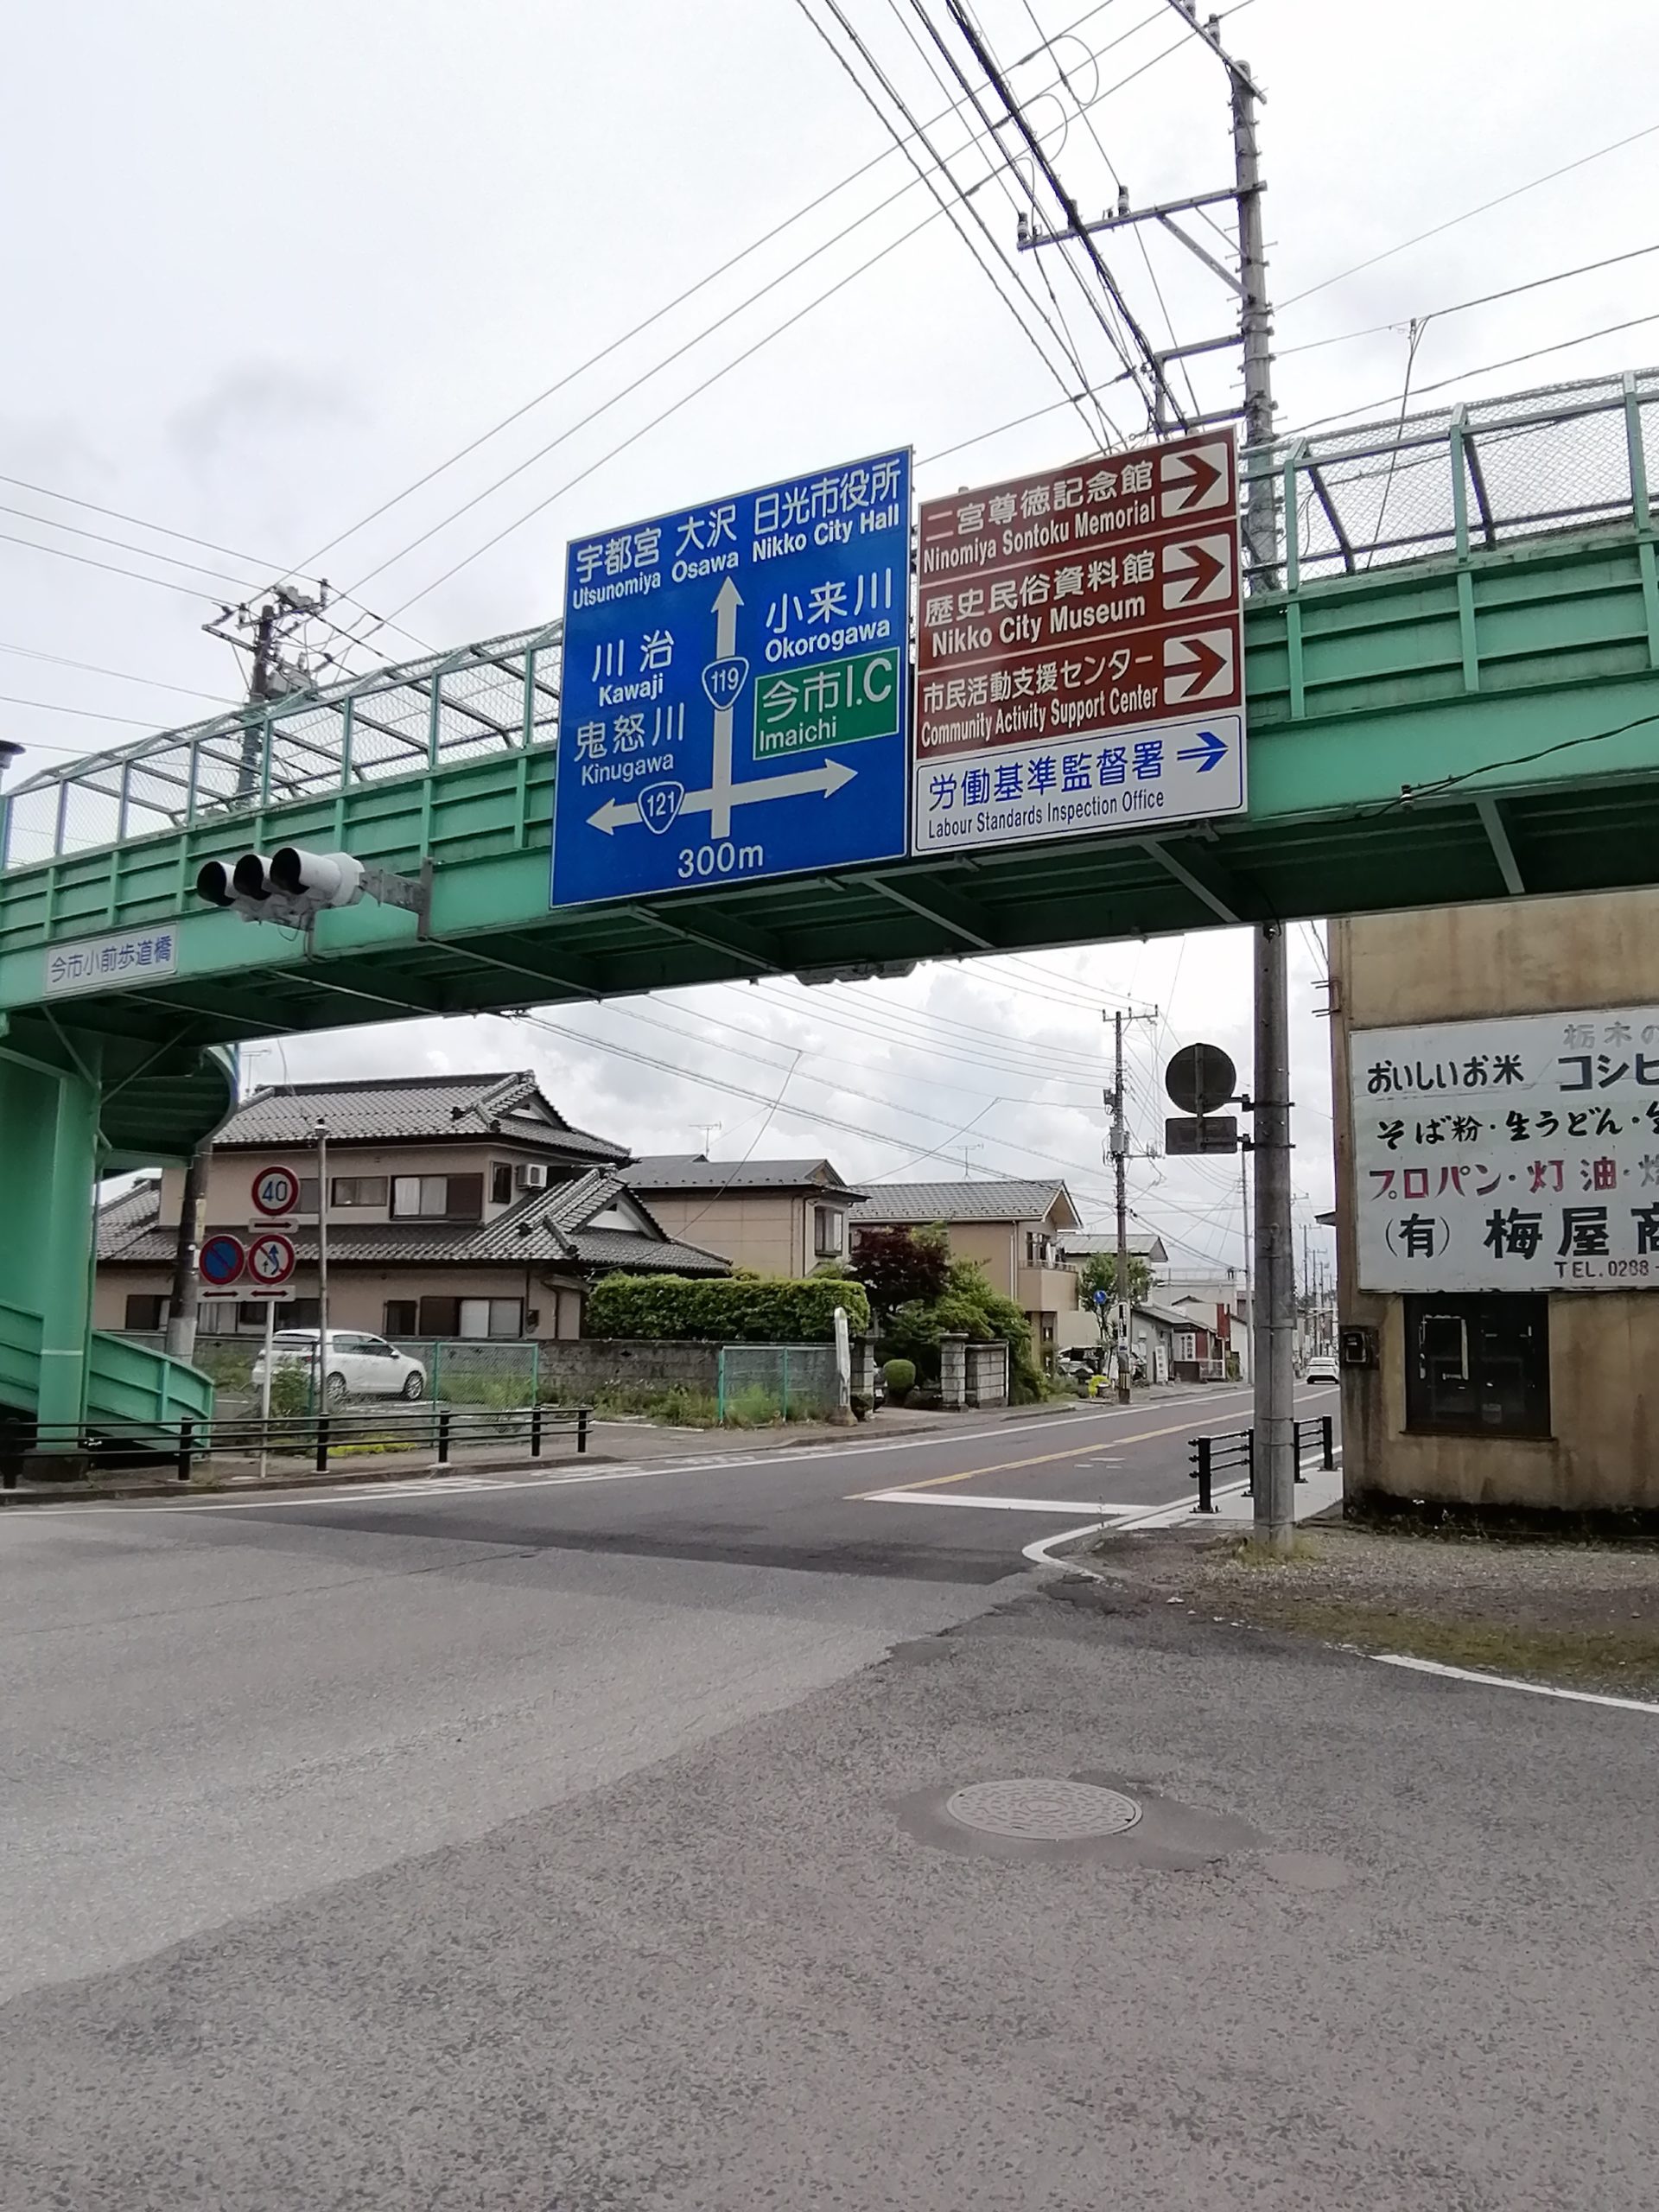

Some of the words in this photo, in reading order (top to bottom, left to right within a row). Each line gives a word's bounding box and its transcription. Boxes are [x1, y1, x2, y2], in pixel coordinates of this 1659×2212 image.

[576, 528, 662, 584] 宇都宮
[675, 504, 736, 556] 大沢
[754, 458, 901, 536] 日光市役所
[925, 460, 1154, 543] 二宮尊徳記念館
[572, 571, 661, 610] Utsunomiya
[671, 551, 739, 583] Osawa
[753, 533, 807, 563] Nikko
[814, 519, 853, 545] City
[860, 503, 899, 535] Hall
[924, 537, 997, 574] Ninomiya
[1002, 518, 1070, 556] Sontoku
[1075, 495, 1156, 539] Memorial
[766, 567, 892, 634] 小来川
[925, 550, 1155, 627] 歴史民俗資料館
[765, 619, 891, 663] Okorogawa
[931, 625, 993, 658] Nikko
[999, 614, 1042, 644] City
[1049, 595, 1147, 634] Museum
[591, 629, 675, 683] 川治
[710, 666, 740, 695] 119
[923, 648, 1154, 714] 市民活動支援センター
[599, 672, 664, 707] Kawaji
[920, 711, 993, 748] Community
[995, 702, 1047, 734] Activity
[1050, 690, 1106, 729] Support
[1109, 683, 1159, 716] Center
[574, 702, 685, 762] 鬼怒川
[760, 715, 837, 752] Imaichi
[582, 753, 674, 787] Kinugawa
[928, 740, 1165, 812] 労働基準監督署
[647, 790, 675, 817] 121
[928, 817, 973, 840] Labour
[976, 805, 1043, 834] Standards
[1047, 795, 1118, 826] Inspection
[1122, 787, 1165, 812] Office
[677, 841, 764, 879] 300m
[50, 935, 173, 983] 今市小前歩道橋
[1367, 1054, 1525, 1095] おいしいお米
[1558, 1053, 1659, 1092] コシヒ
[262, 1180, 289, 1202] 40
